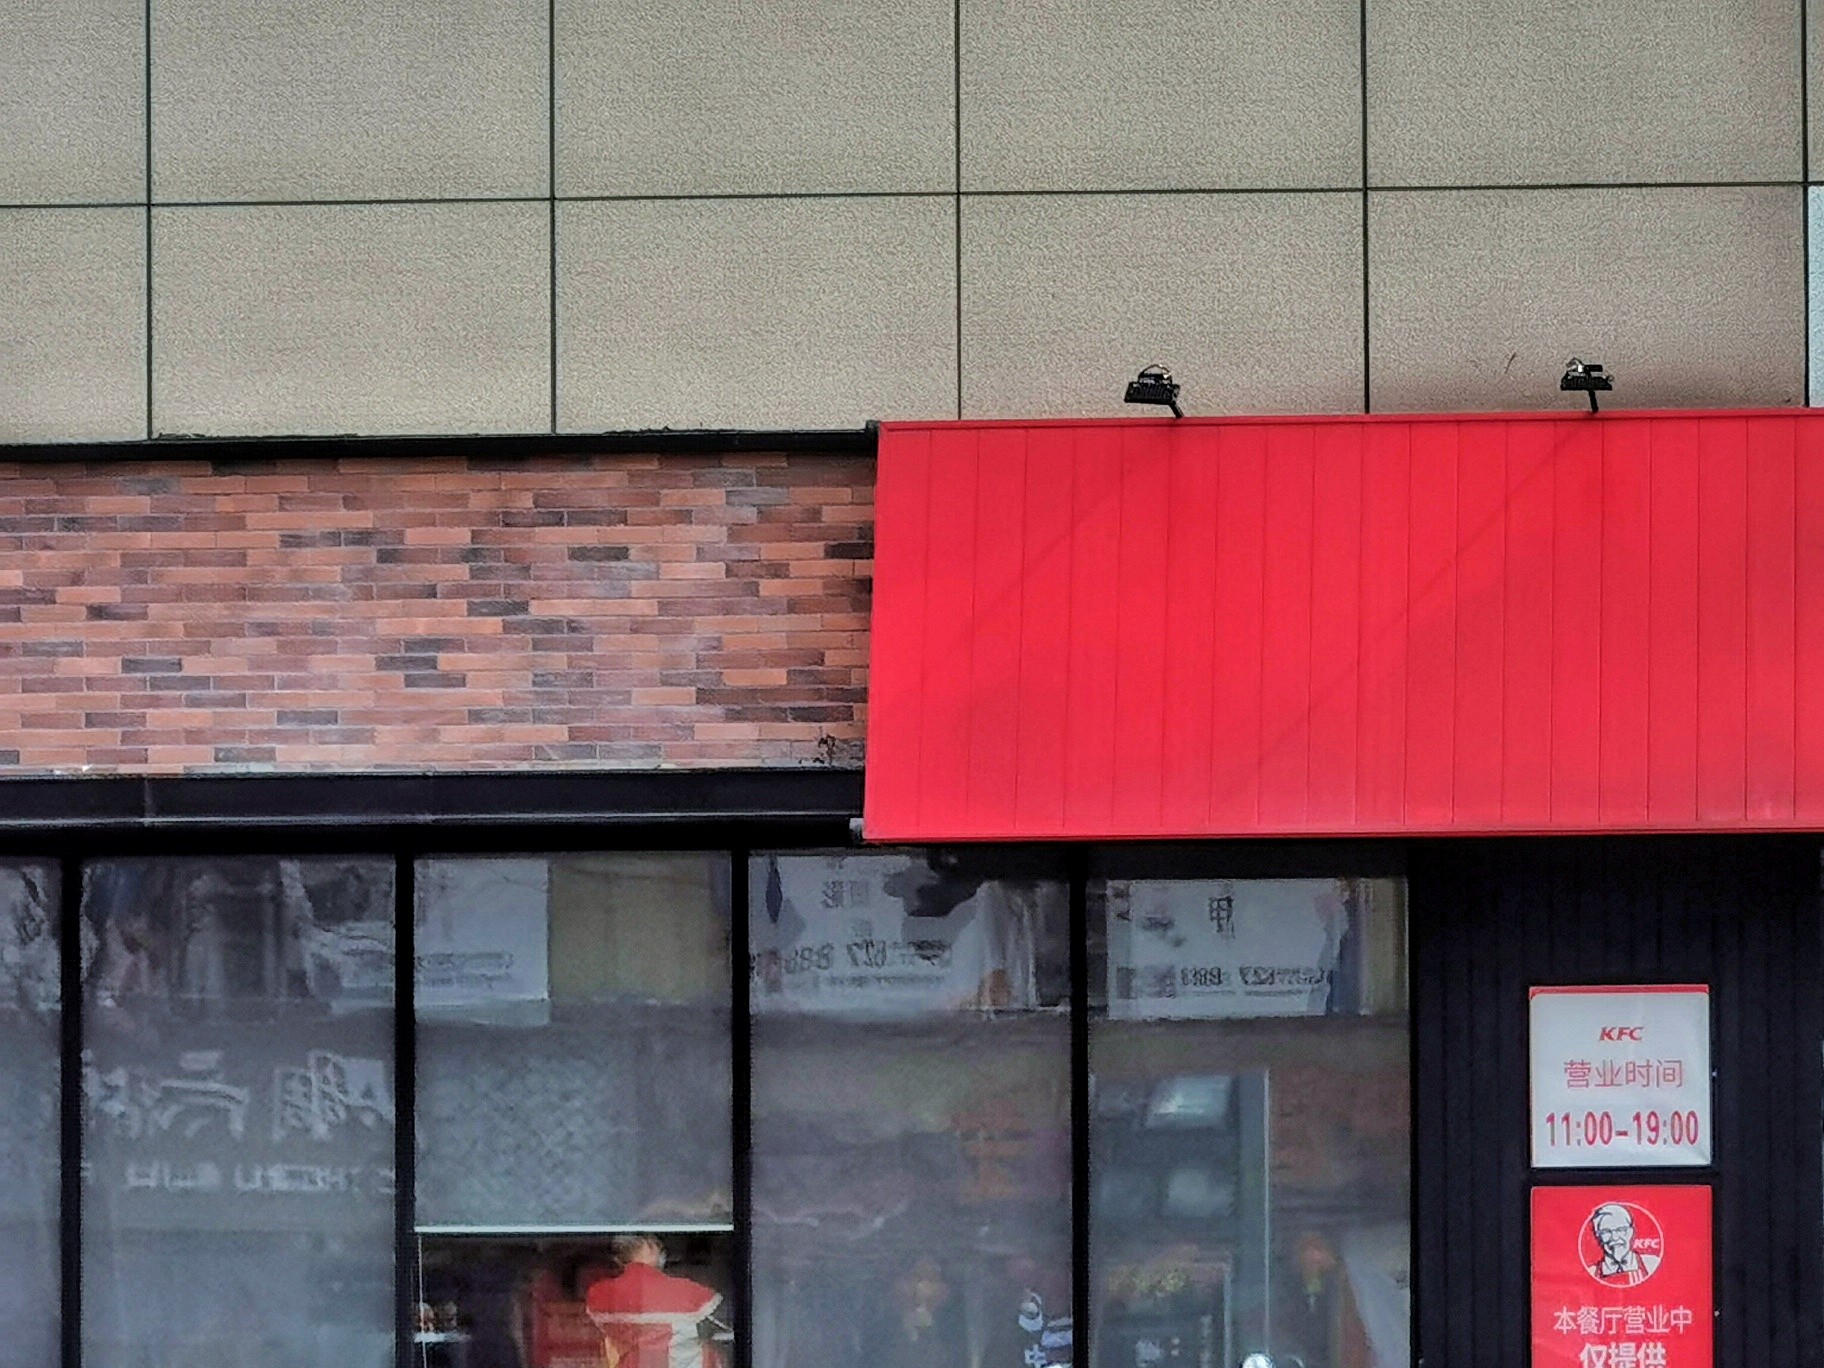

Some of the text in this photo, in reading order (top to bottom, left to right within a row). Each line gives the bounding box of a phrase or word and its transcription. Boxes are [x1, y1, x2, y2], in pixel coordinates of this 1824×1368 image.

[1599, 1026, 1644, 1041] KFC
[1563, 1059, 1683, 1088] 营业时间
[1546, 1110, 1698, 1146] 11:00-19:00
[1633, 1238, 1660, 1249] KFC
[1553, 1304, 1693, 1335] 本餐厅营业中
